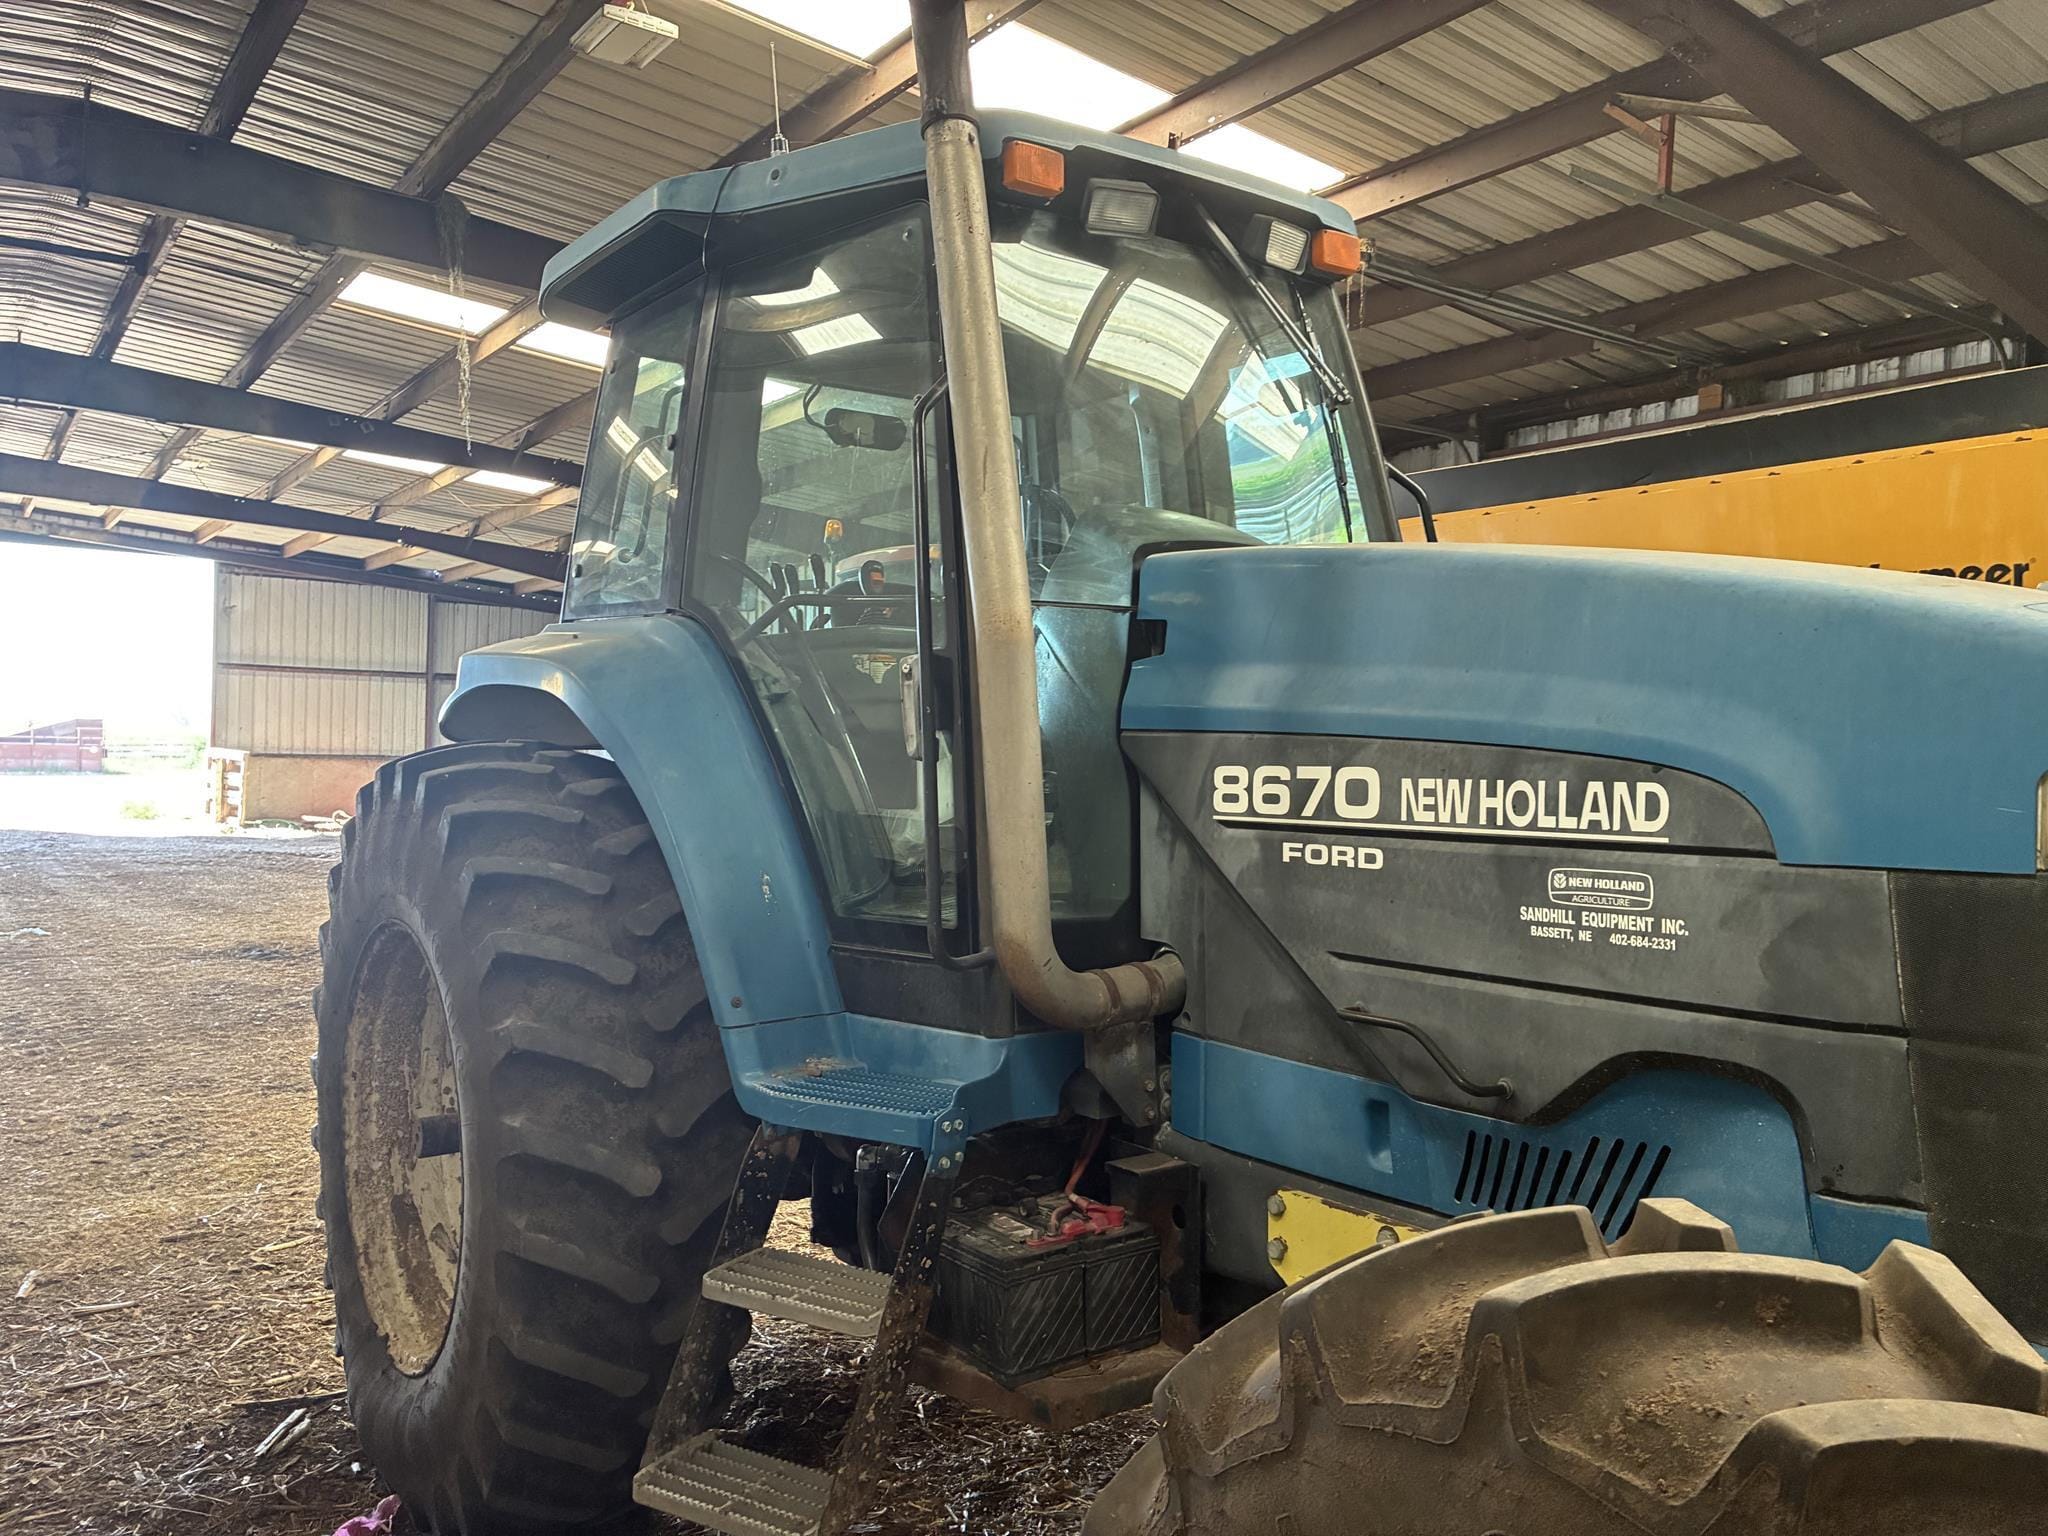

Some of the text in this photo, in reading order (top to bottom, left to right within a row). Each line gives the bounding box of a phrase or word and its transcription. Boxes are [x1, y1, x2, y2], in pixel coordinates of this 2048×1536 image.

[1212, 765, 1381, 819] 8670
[1282, 842, 1384, 870] FORD
[1568, 877, 1645, 892] NEW HOLLAND
[1571, 895, 1631, 907] AGRICULTURE
[1520, 906, 1689, 936] SANDHILL EQUIPMENT INC.
[1530, 925, 1676, 951] BASSETT, NE 402-684-2331
